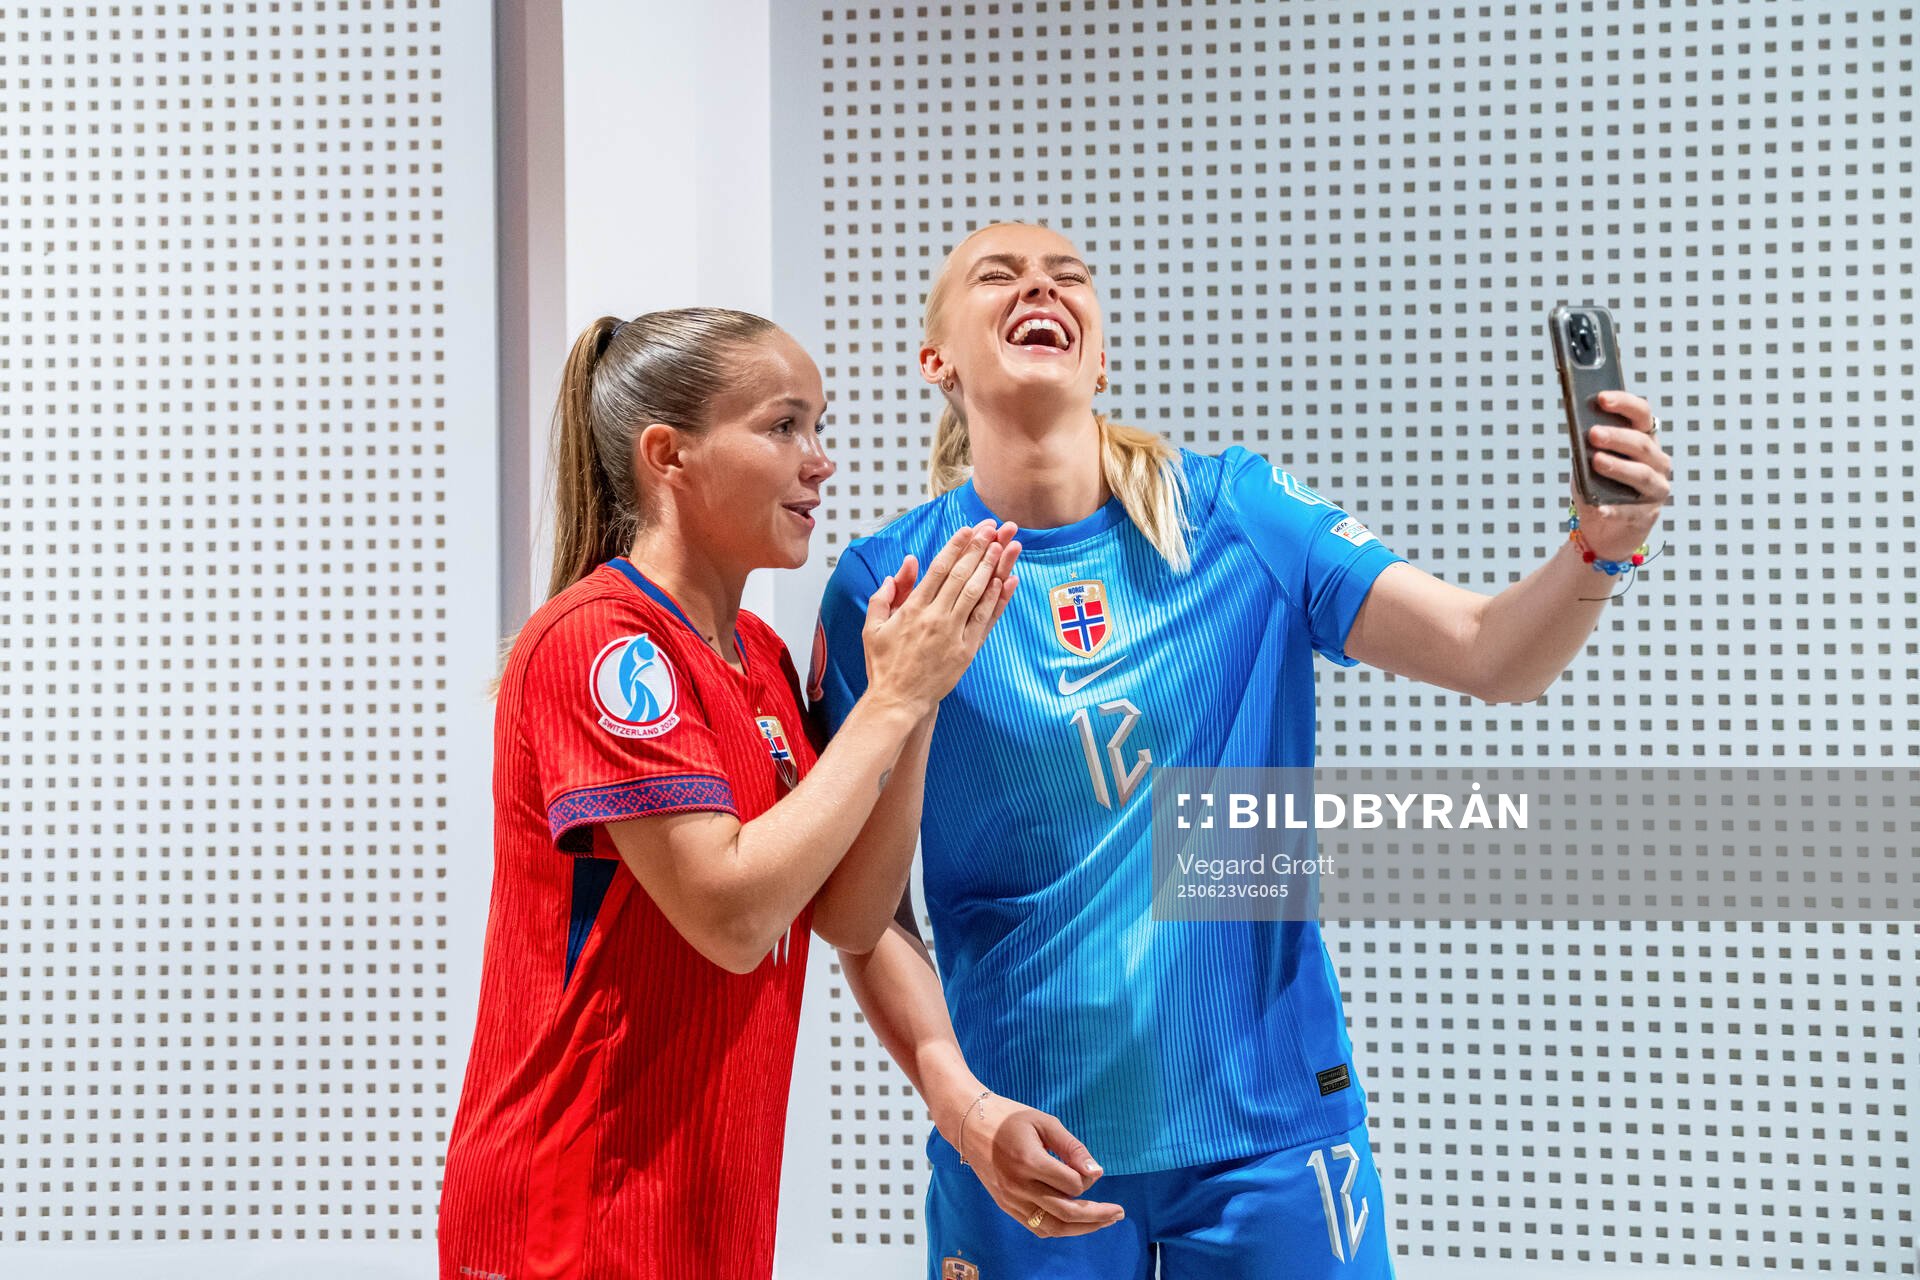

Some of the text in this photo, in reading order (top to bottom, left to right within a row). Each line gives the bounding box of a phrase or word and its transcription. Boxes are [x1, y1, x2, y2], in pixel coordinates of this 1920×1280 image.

[601, 716, 677, 736] SWITZERLAND 2025
[1069, 698, 1152, 811] 12
[1306, 1142, 1369, 1265] 12
